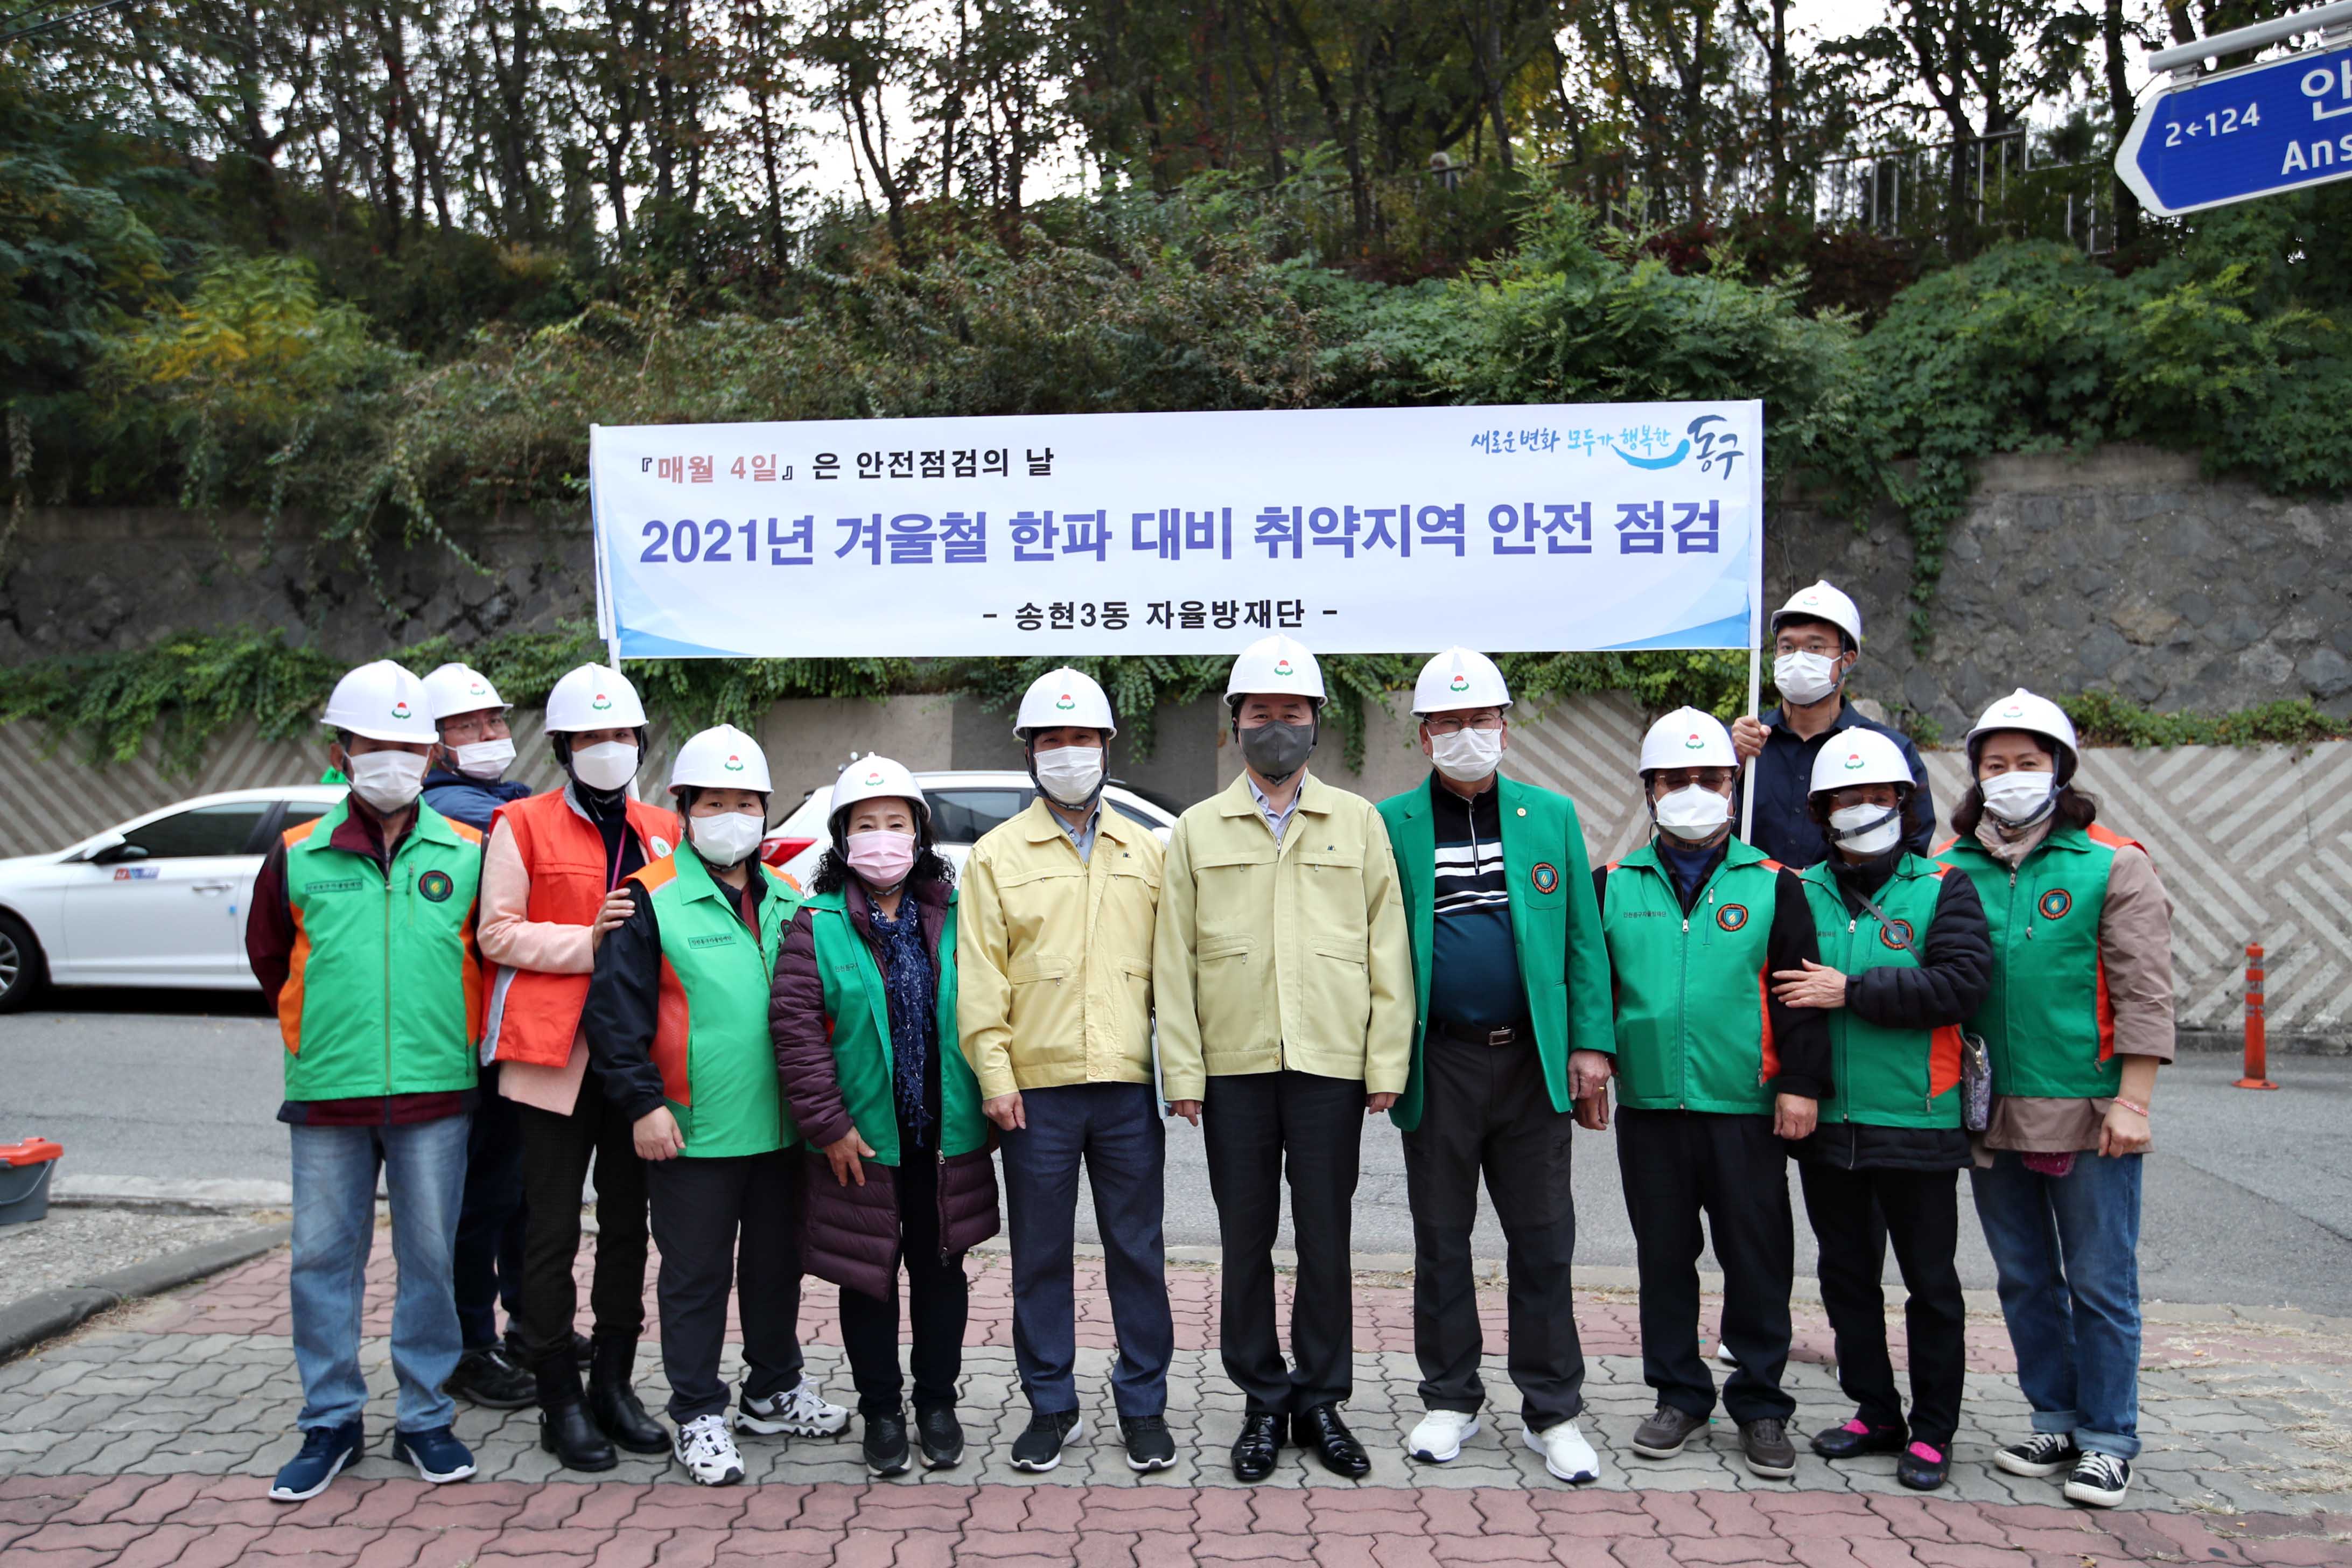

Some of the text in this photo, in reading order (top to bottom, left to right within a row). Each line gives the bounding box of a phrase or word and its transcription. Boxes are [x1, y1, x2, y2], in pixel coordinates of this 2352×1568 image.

[642, 456, 713, 484] 『매월
[813, 453, 840, 479] 은
[856, 448, 1009, 478] 안전점검의
[1027, 448, 1054, 475] 날
[1567, 429, 1614, 457] 모두가
[1620, 424, 1671, 456] 행복한
[1688, 415, 1744, 480] 동구
[640, 500, 1719, 565] 2021년 겨울철 한파 대비 취약지역 안전 점검
[1016, 602, 1129, 631] 송현3동
[1146, 600, 1304, 629] 자율방재단
